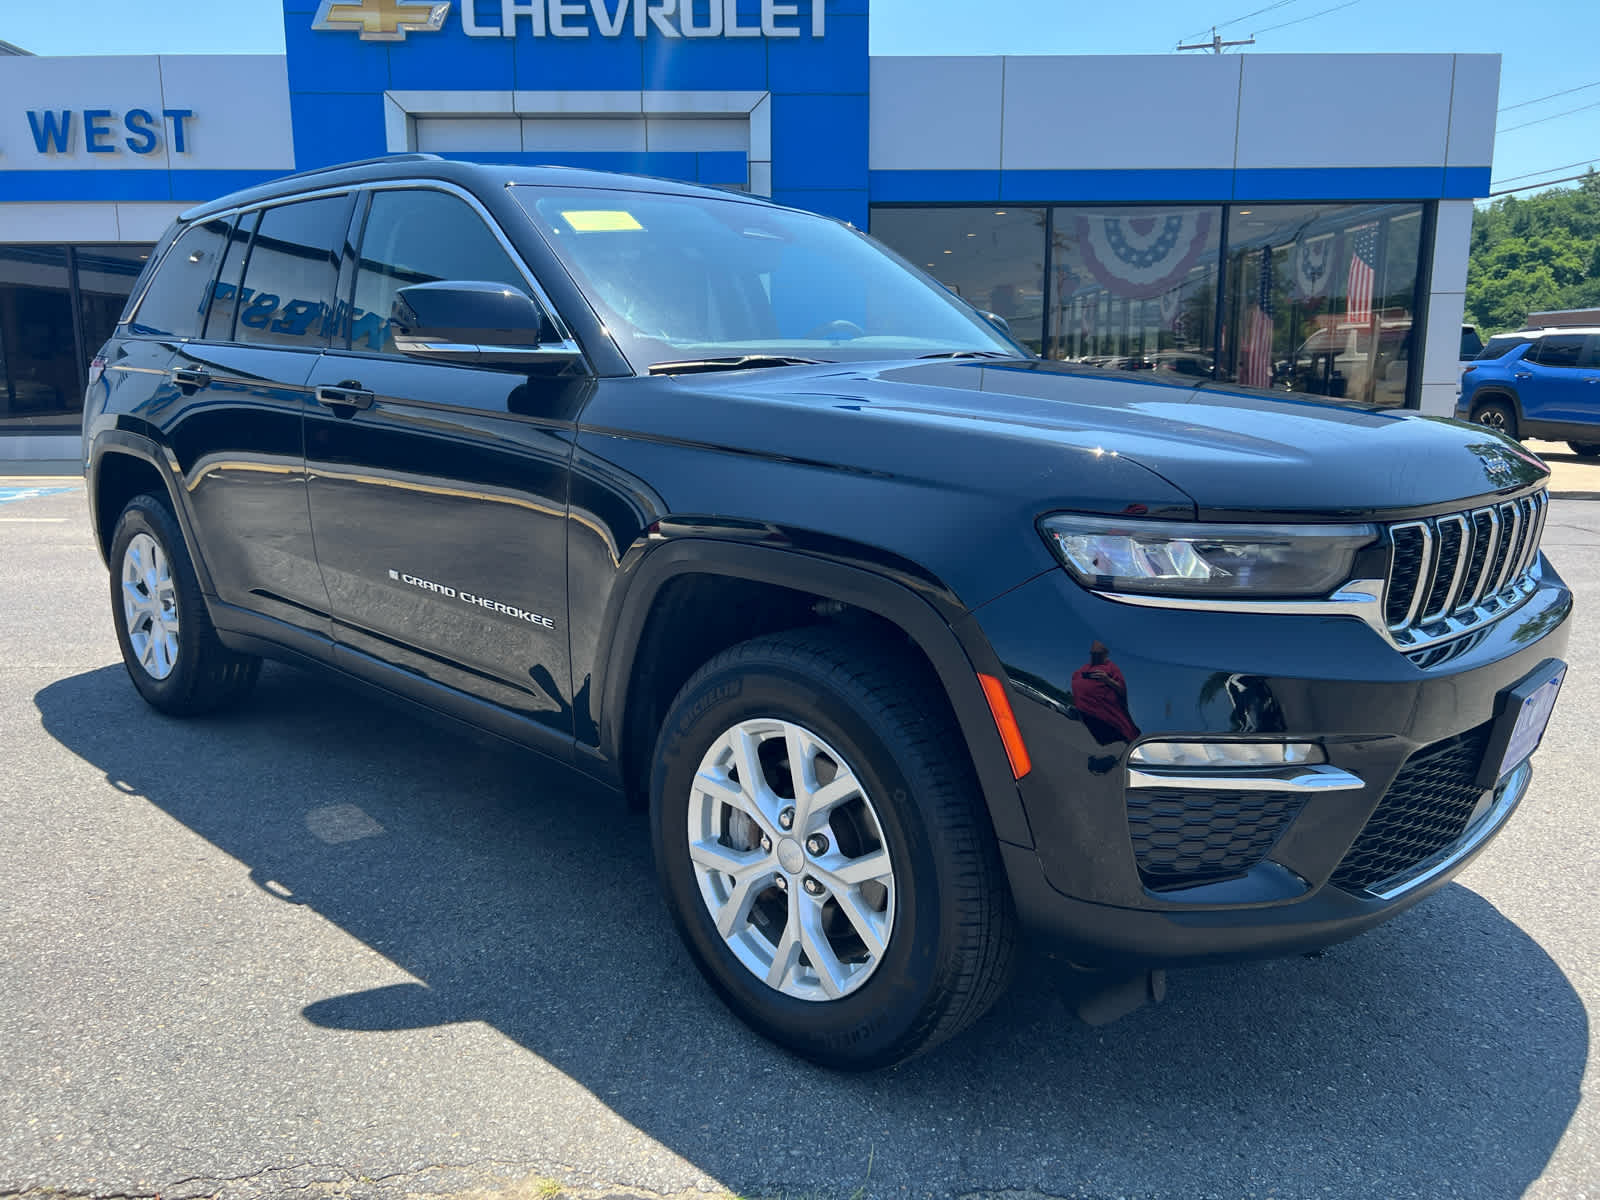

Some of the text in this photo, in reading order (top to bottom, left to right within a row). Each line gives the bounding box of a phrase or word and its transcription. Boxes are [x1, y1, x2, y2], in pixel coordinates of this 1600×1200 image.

[461, 0, 826, 38] CHEVROLET
[25, 108, 193, 154] WEST
[402, 573, 555, 630] GRAND CHEROKEE
